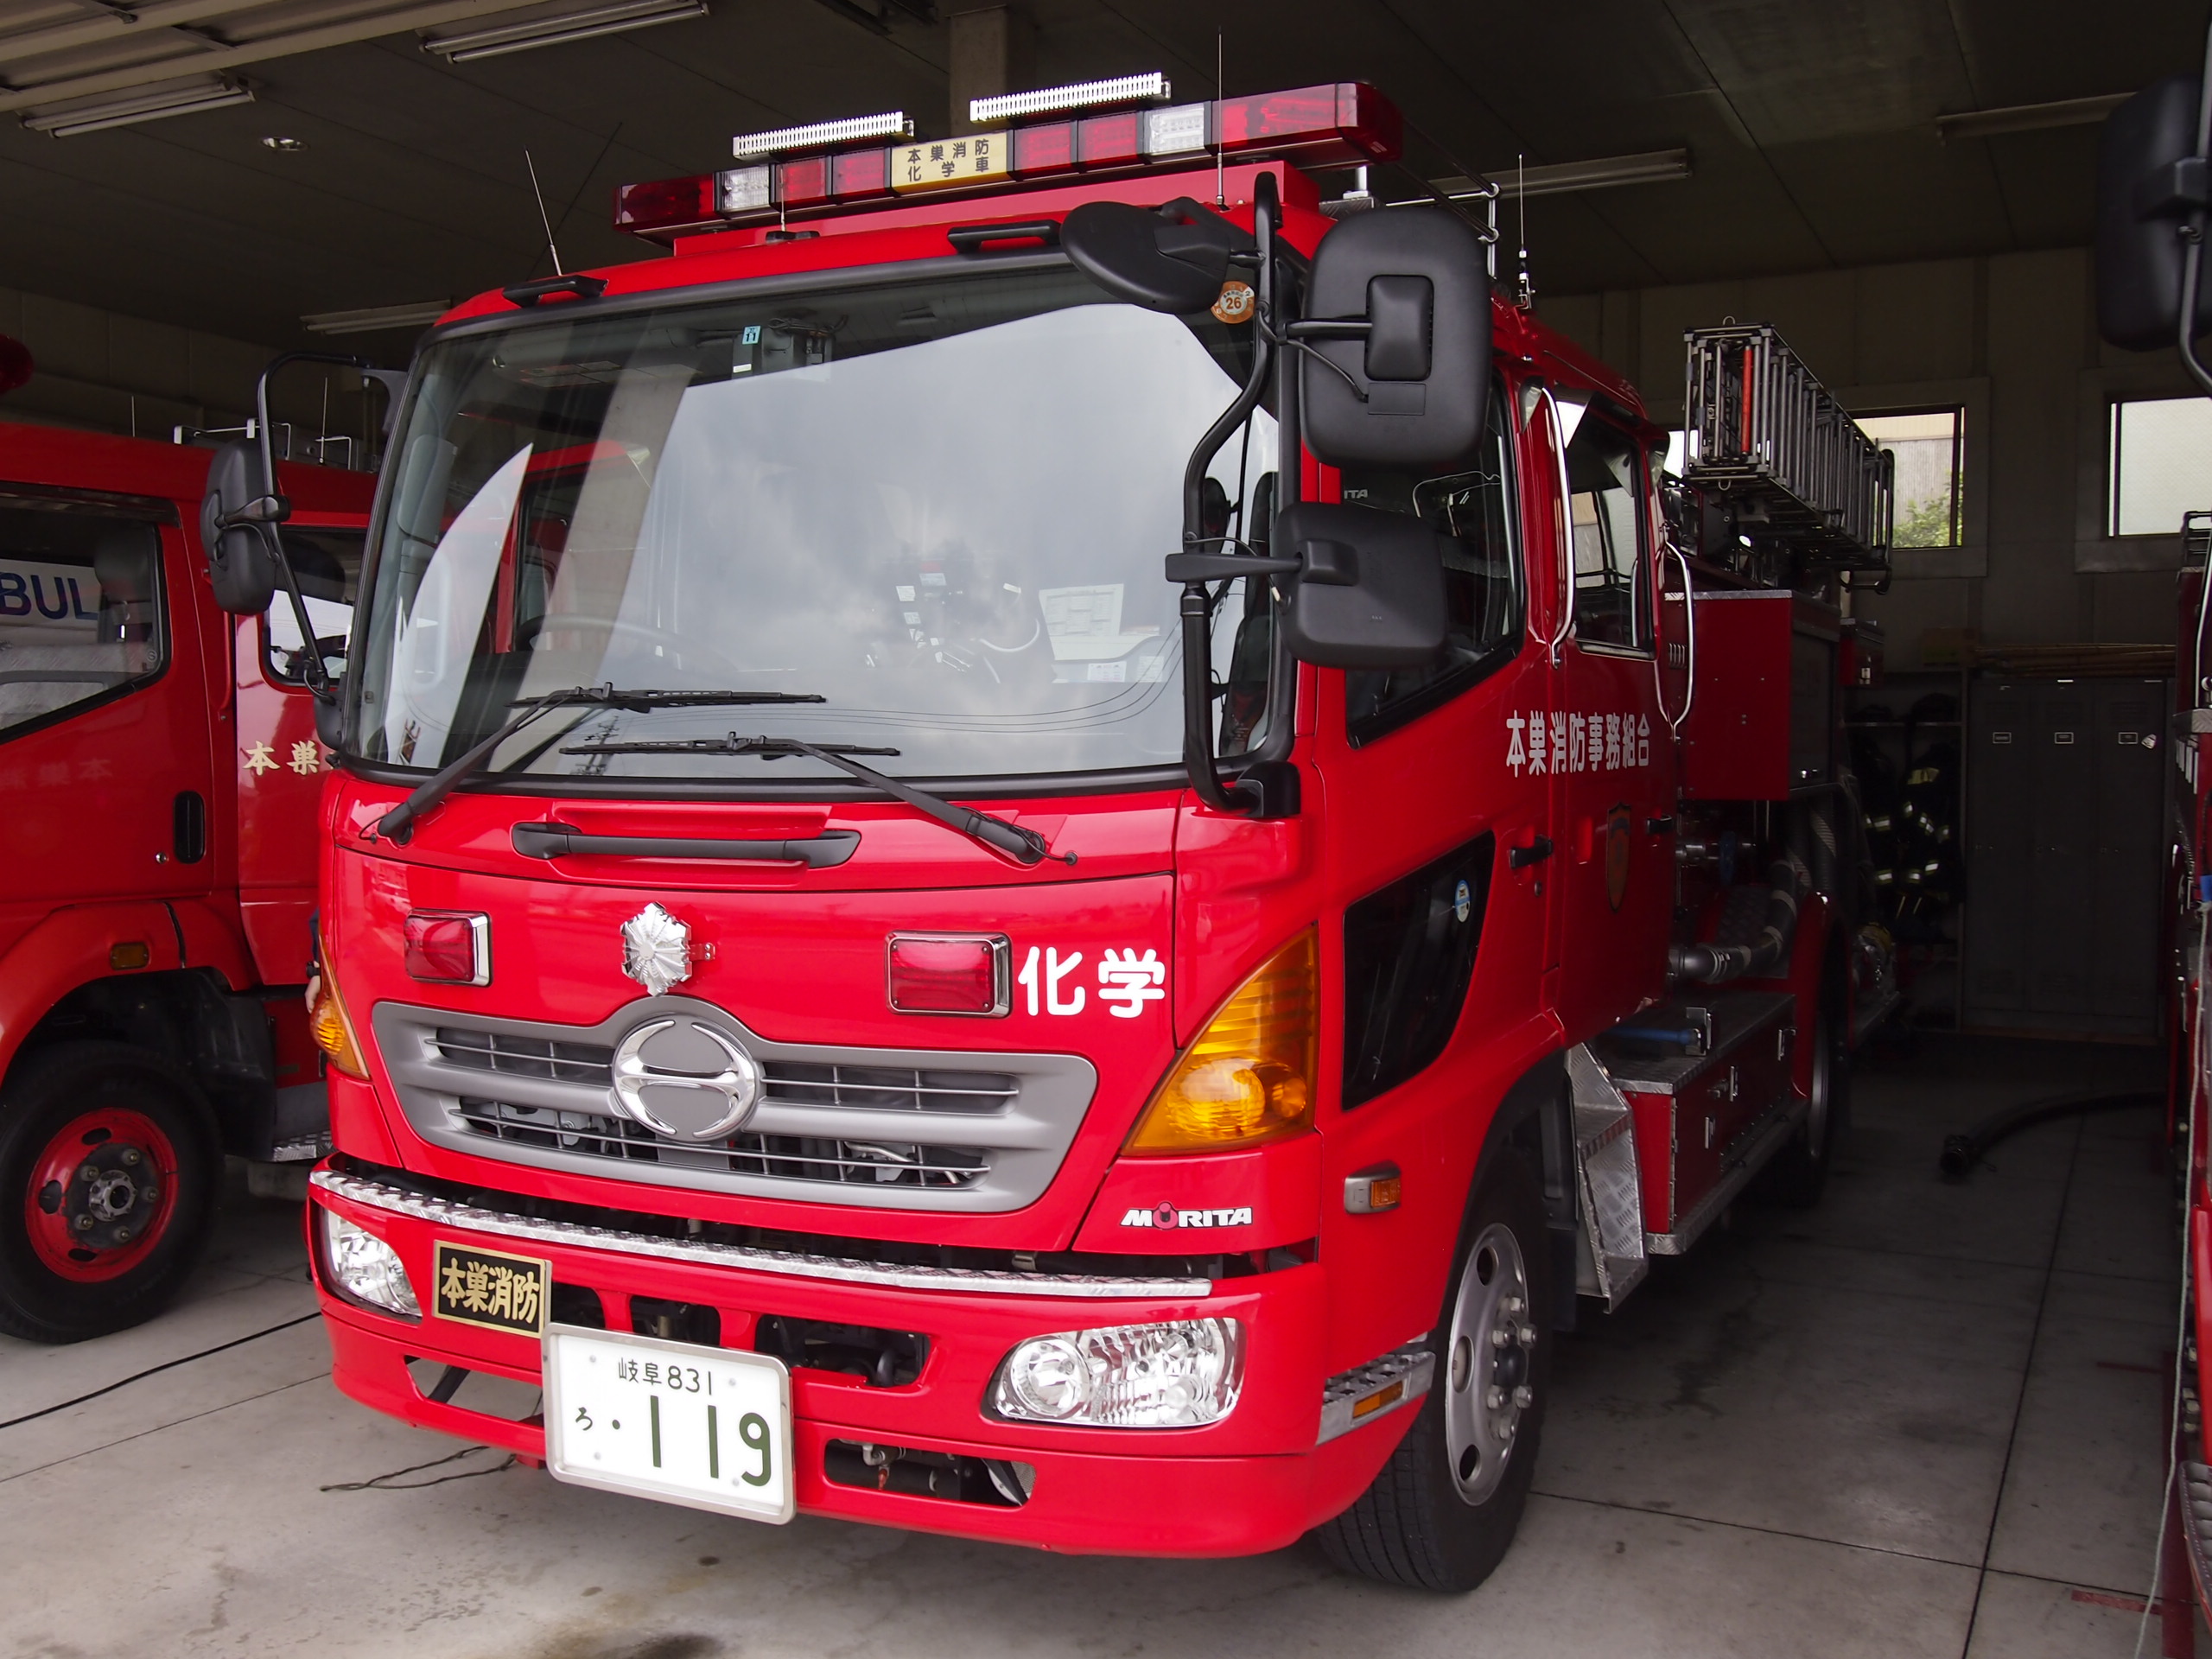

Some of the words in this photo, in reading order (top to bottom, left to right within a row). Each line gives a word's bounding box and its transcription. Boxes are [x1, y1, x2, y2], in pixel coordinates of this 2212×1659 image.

[907, 138, 989, 165] 本巣消防
[907, 156, 989, 182] 化学車
[1225, 297, 1243, 310] 26
[746, 333, 757, 342] 11
[1506, 709, 1650, 778] 本巣消防事務組合
[242, 740, 335, 776] 本巣
[1018, 946, 1166, 1019] 化学
[1120, 1202, 1253, 1230] MORITA
[441, 1257, 540, 1324] 本巣消防
